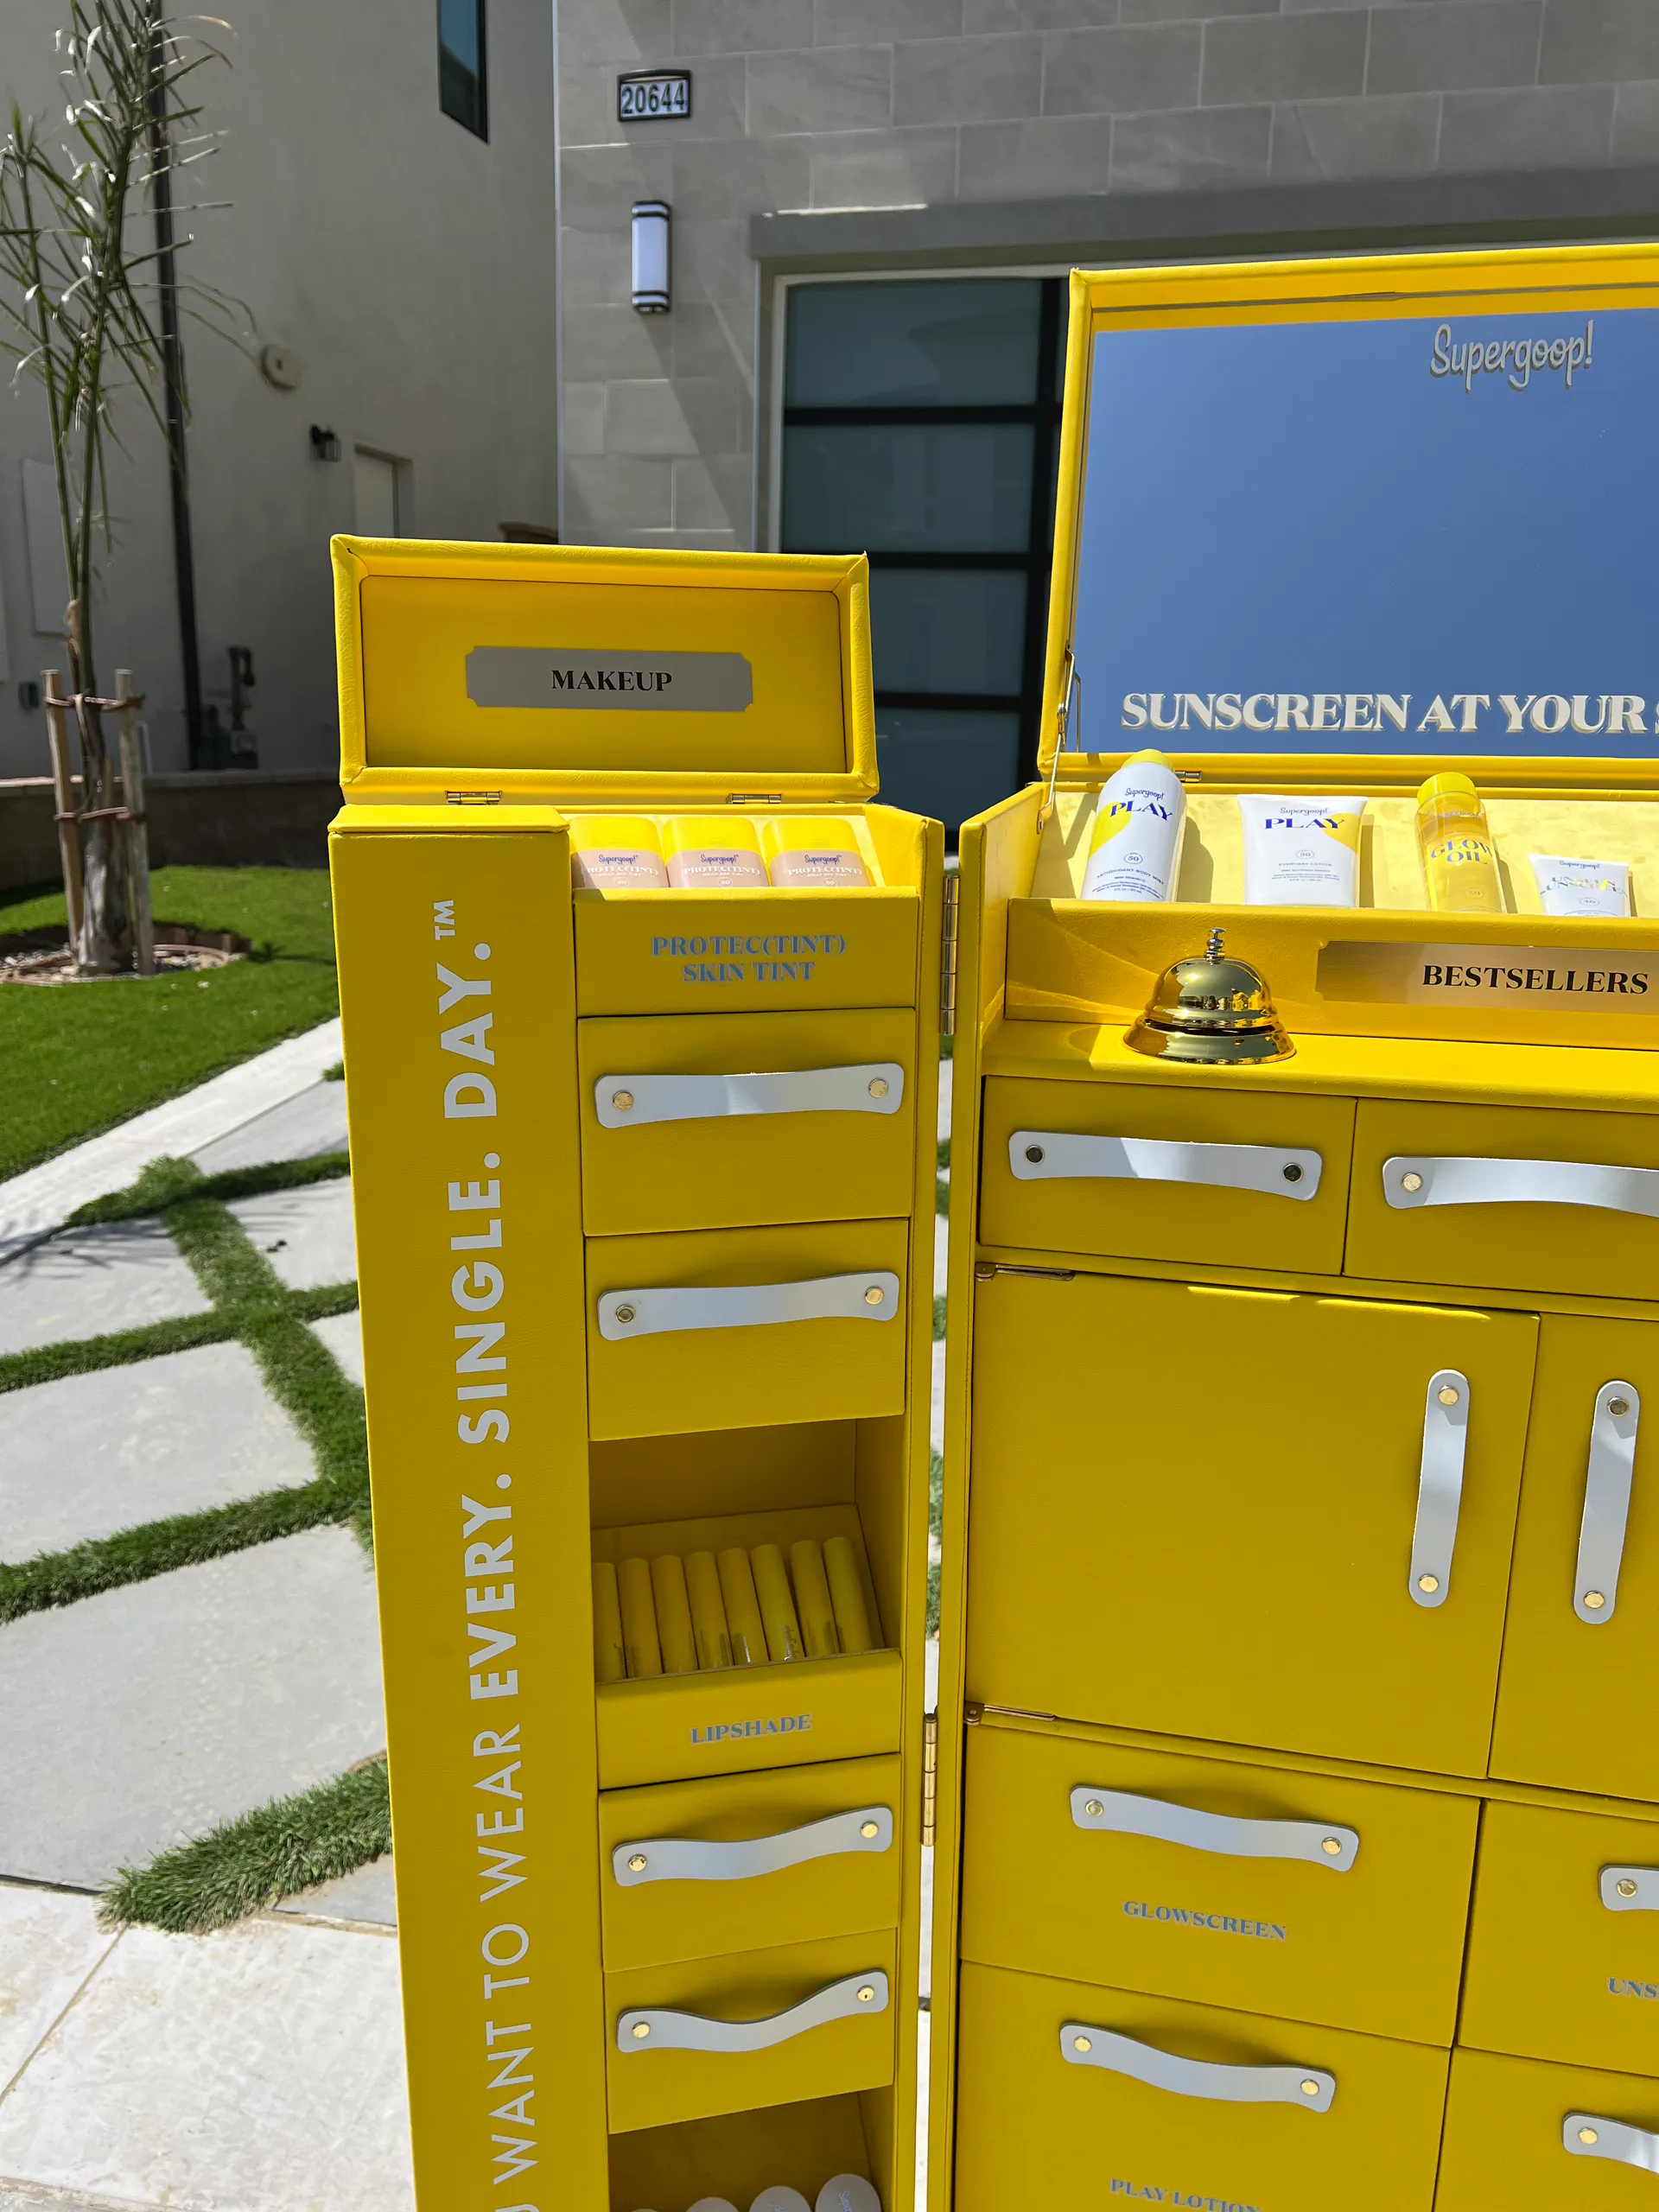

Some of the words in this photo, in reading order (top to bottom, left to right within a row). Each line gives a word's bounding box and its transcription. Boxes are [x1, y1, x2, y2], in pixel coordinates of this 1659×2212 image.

[621, 81, 688, 115] 20644
[1430, 320, 1593, 394] Supergoop!
[551, 670, 672, 692] MAKEUP
[1121, 693, 1414, 732] SUNSCREEN
[1415, 694, 1492, 733] AT
[1497, 695, 1649, 734] YOUR
[1125, 787, 1165, 801] Supergoop!
[1110, 800, 1173, 822] PLAY
[1265, 817, 1345, 830] PLAY
[1280, 807, 1328, 816] Supergoop!
[588, 866, 658, 875] ROTEC(TINT)
[651, 934, 847, 957] PROTEC(TINT)
[683, 963, 745, 983] SKIN
[751, 961, 816, 982] TINT
[1422, 963, 1649, 995] BESTSELLERS
[448, 1152, 510, 1444] SINGLE.
[461, 1474, 518, 1700] EVERY.
[690, 1713, 812, 1745] LIPSHADE
[473, 1723, 528, 1903] WEAR
[1122, 1900, 1287, 1942] GLOWSCREEN
[481, 1923, 530, 1999] TO
[486, 2020, 539, 2185] WANT
[1110, 2177, 1169, 2202] PLAY
